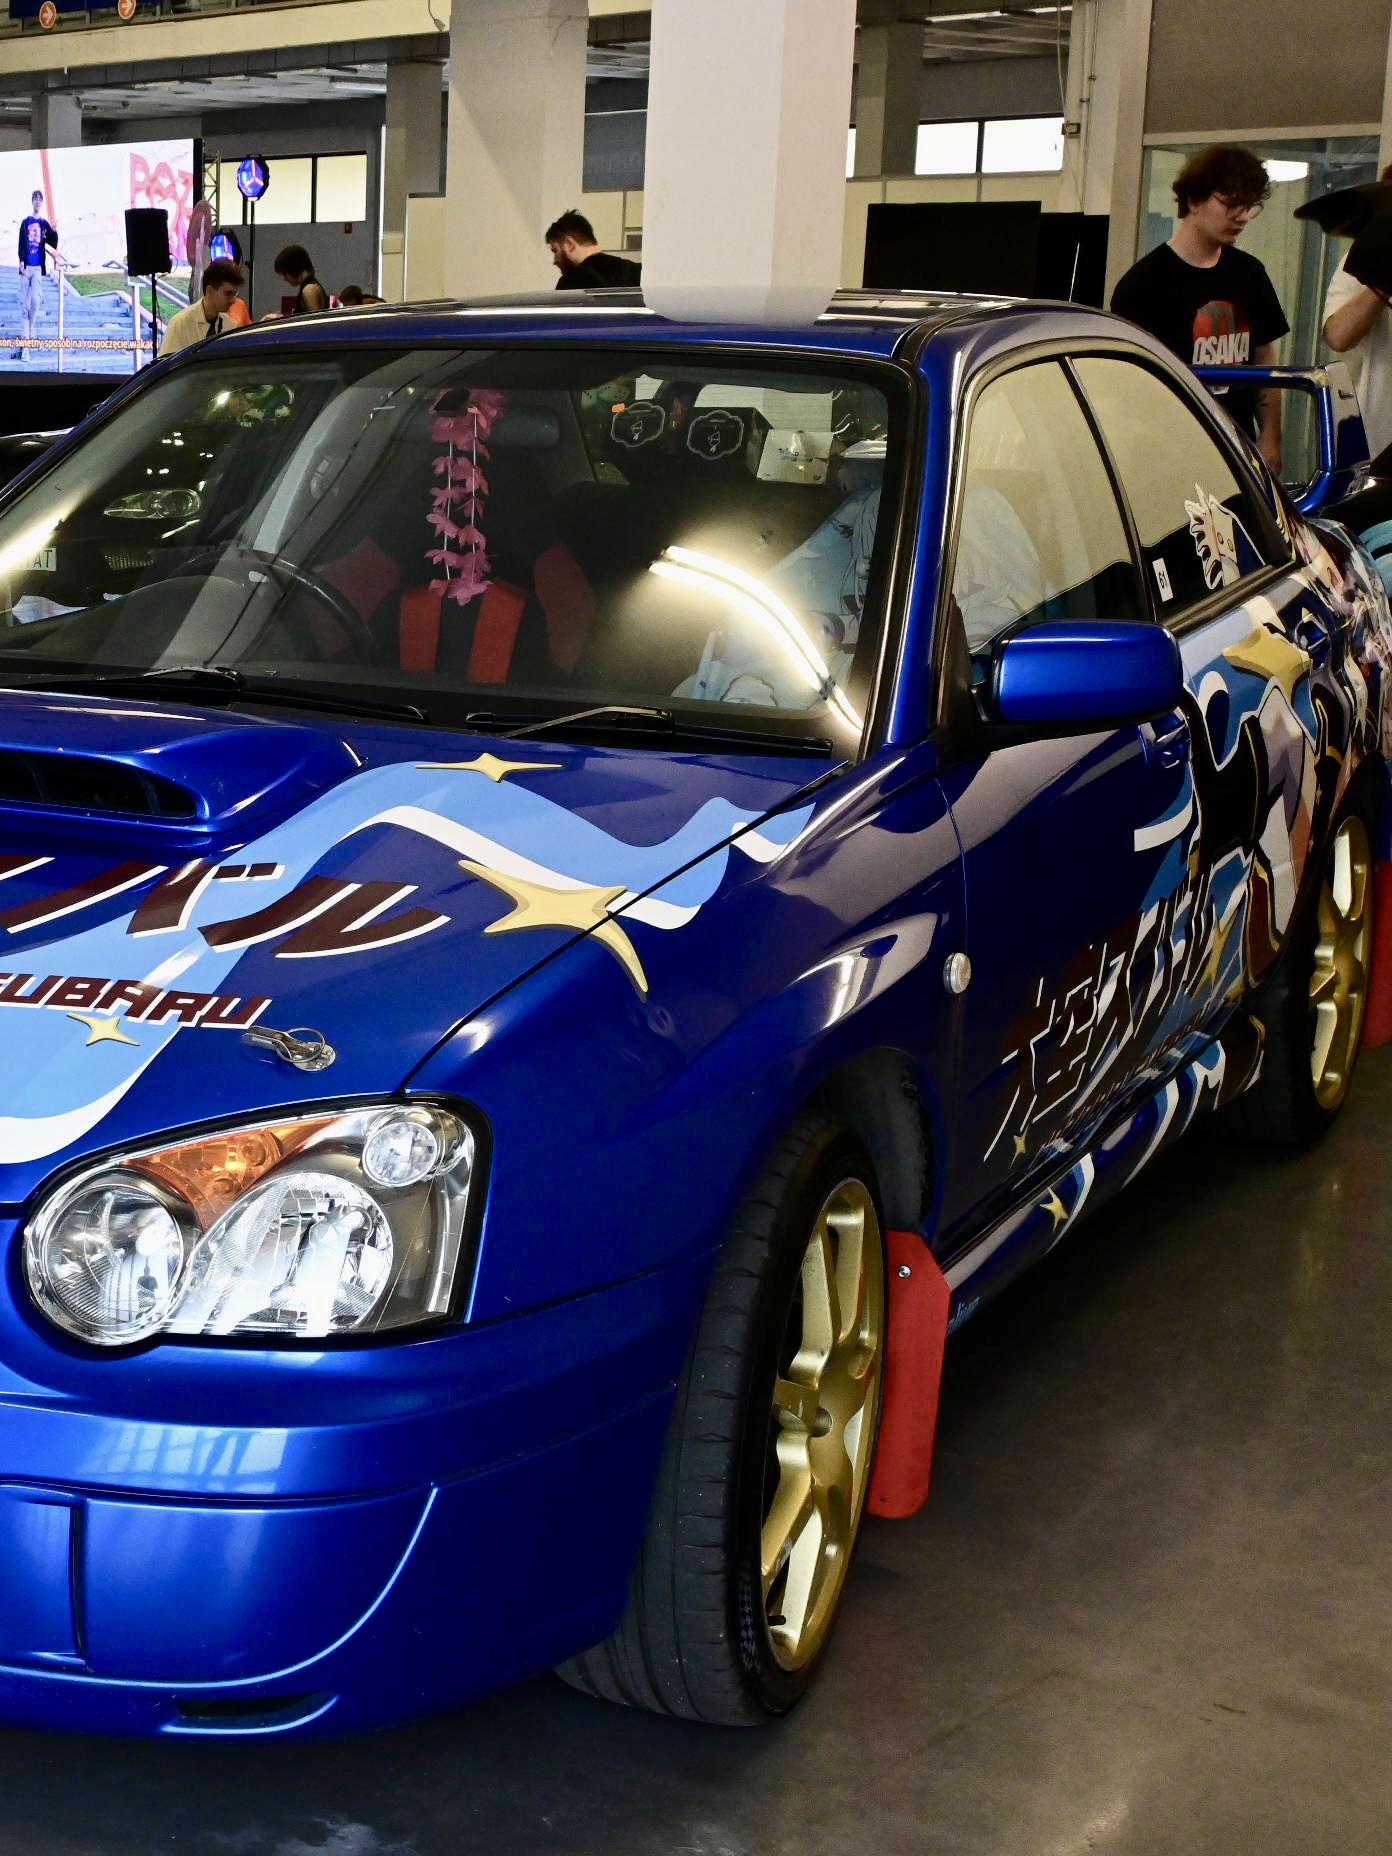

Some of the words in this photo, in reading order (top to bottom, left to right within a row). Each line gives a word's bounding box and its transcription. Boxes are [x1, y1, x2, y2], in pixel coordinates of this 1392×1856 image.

[15, 337, 44, 349] świetny
[45, 337, 71, 349] sposób
[72, 339, 82, 348] na
[84, 338, 128, 350] rozpoczęcie
[1192, 331, 1249, 365] OSAKA
